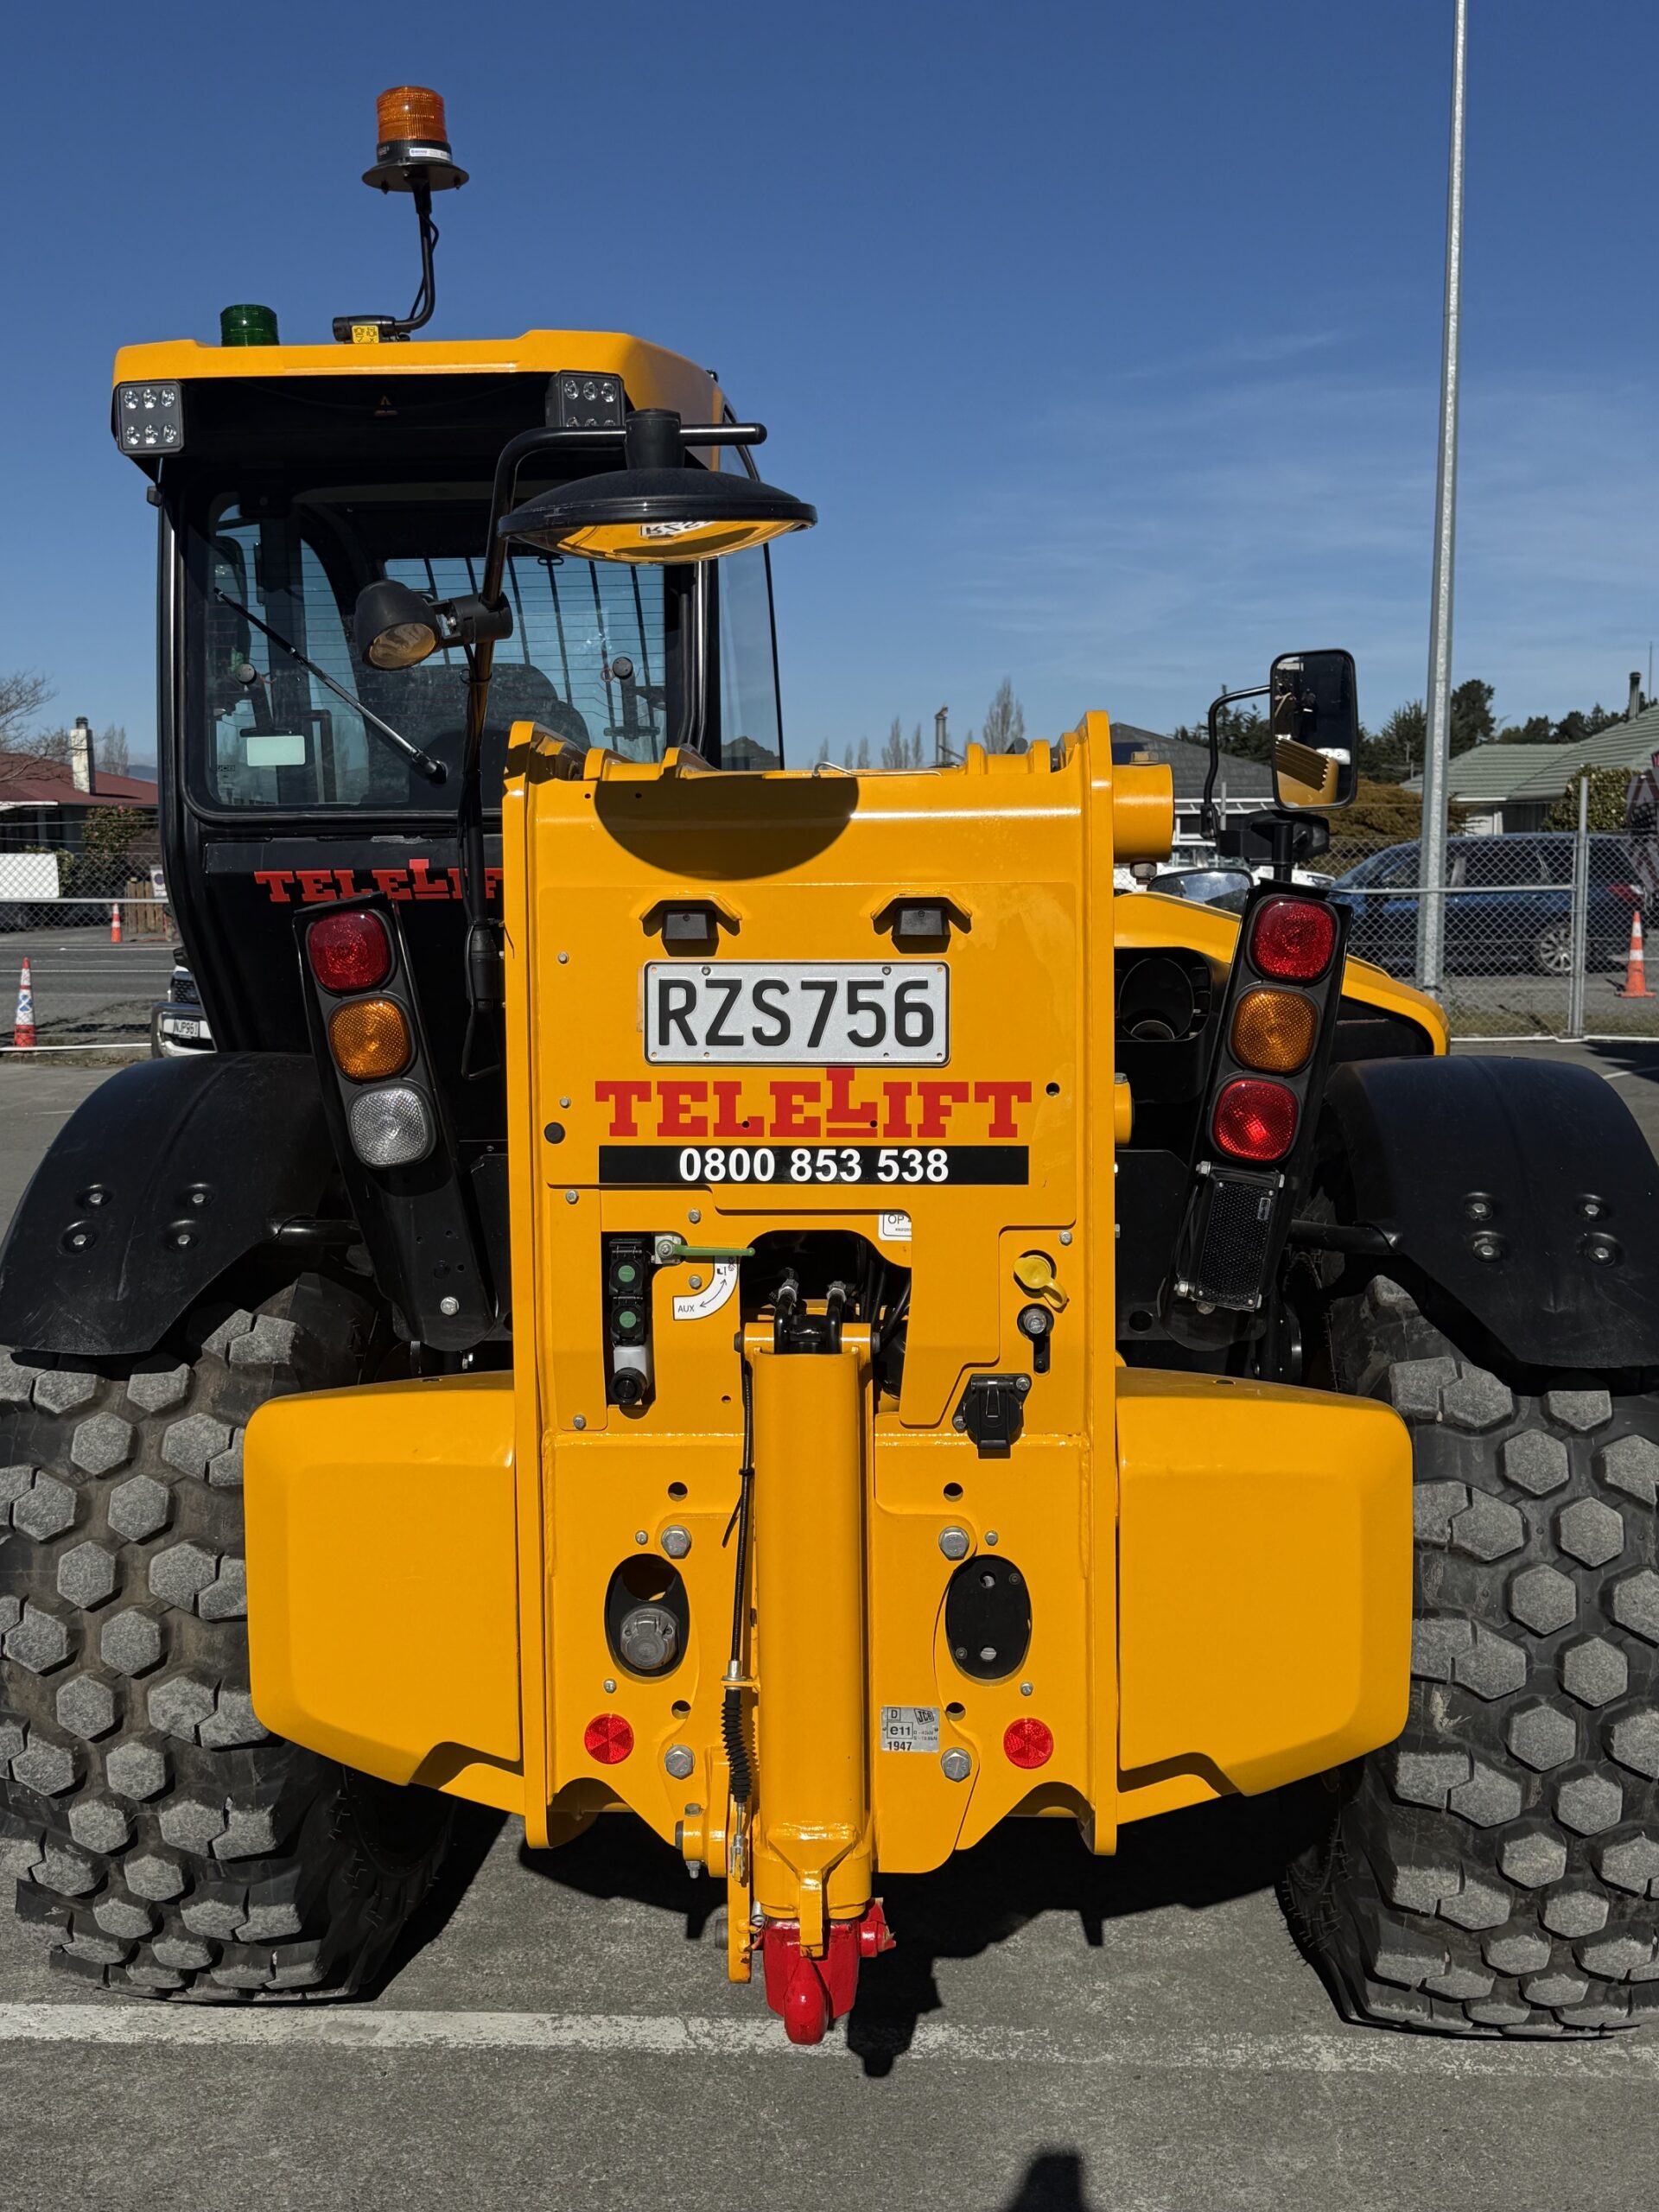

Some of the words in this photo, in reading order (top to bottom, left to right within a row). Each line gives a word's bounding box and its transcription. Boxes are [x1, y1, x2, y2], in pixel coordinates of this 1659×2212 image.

[658, 978, 934, 1047] RZS756
[595, 1065, 1033, 1138] TELELIFT
[679, 1148, 776, 1182] 0800
[790, 1148, 862, 1182] 853
[877, 1148, 949, 1182] 538
[677, 1305, 695, 1313] AUX
[891, 1710, 898, 1719] D
[917, 1710, 934, 1724] JCB
[890, 1726, 911, 1736] e11
[887, 1741, 912, 1751] 1947
